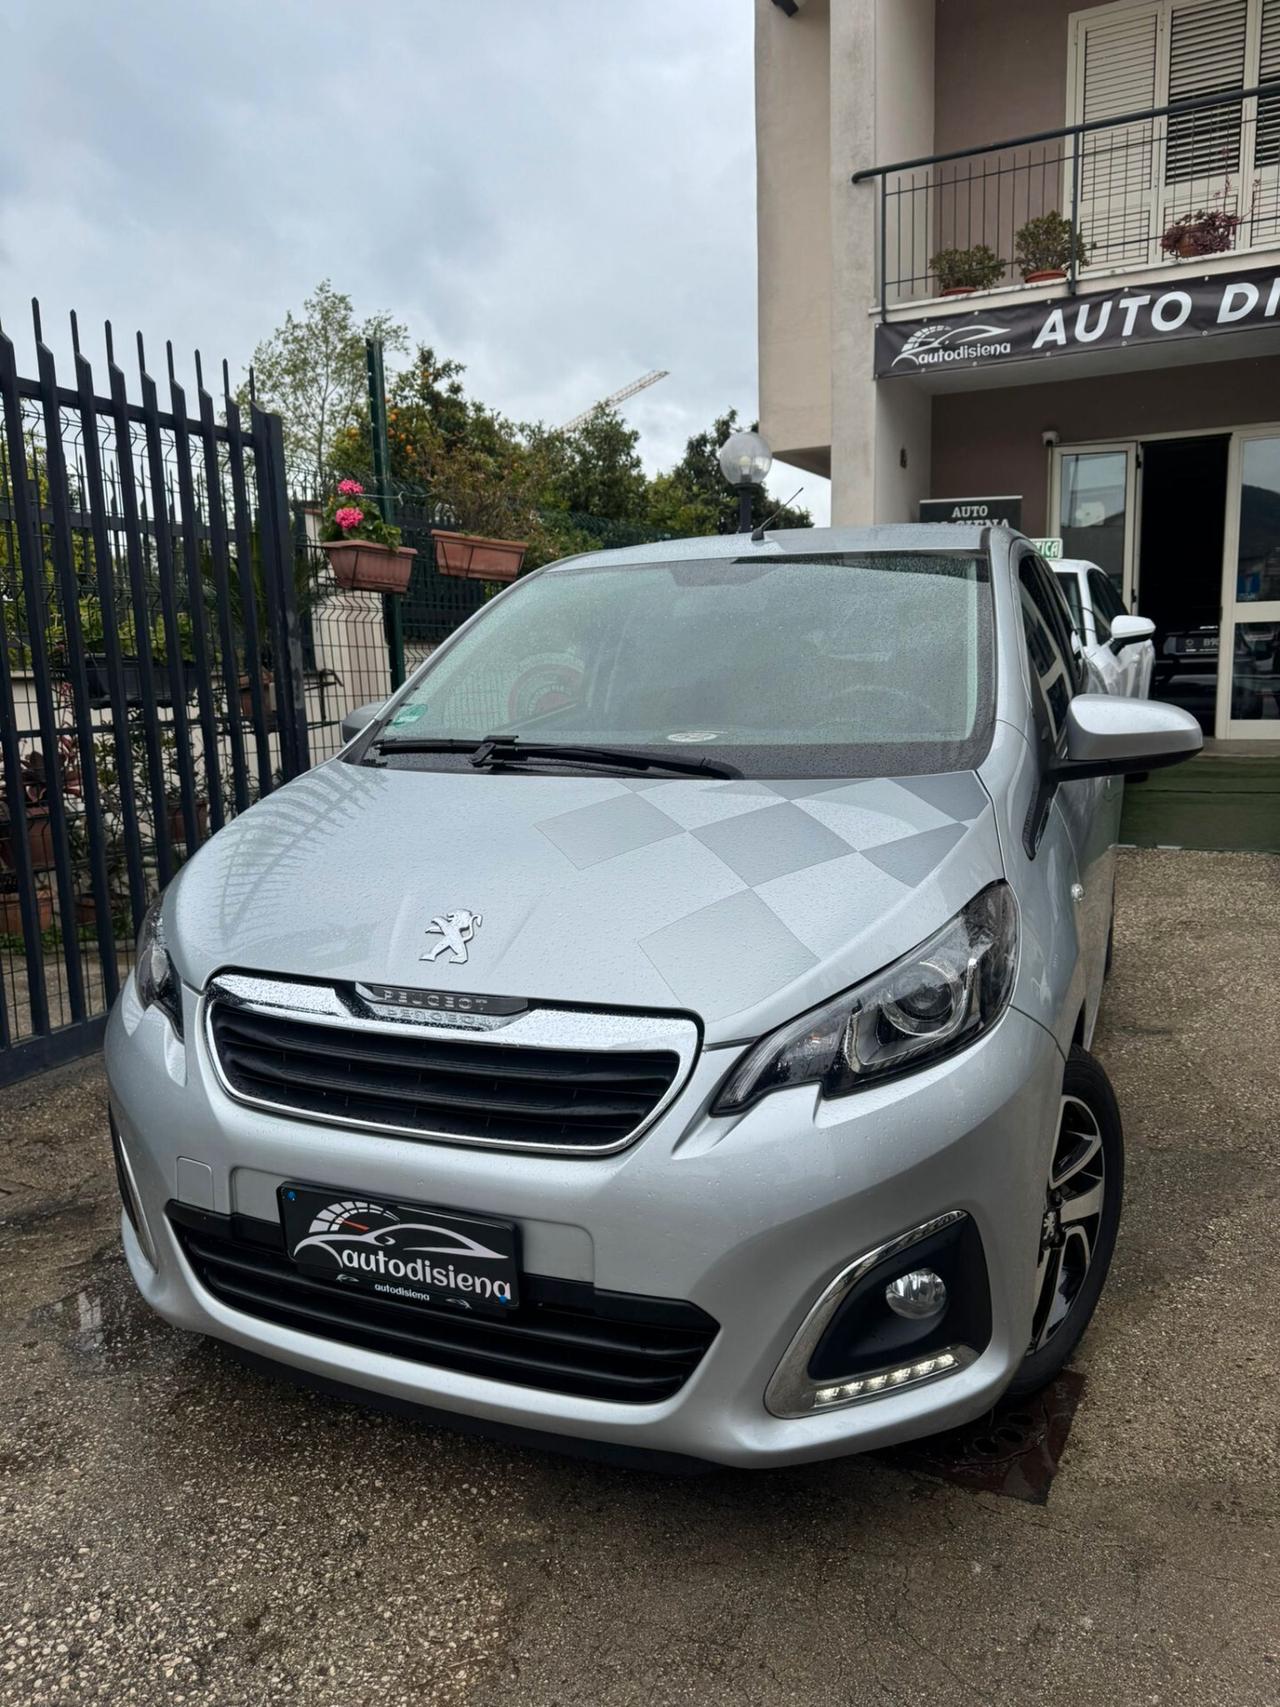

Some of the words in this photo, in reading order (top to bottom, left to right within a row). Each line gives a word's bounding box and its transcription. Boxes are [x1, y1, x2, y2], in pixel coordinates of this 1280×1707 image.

[1032, 291, 1193, 348] AUTO
[918, 341, 1011, 365] autodisiena
[952, 505, 989, 518] AUTO
[341, 1249, 511, 1300] autodisiena
[374, 1283, 430, 1301] autodisiena
